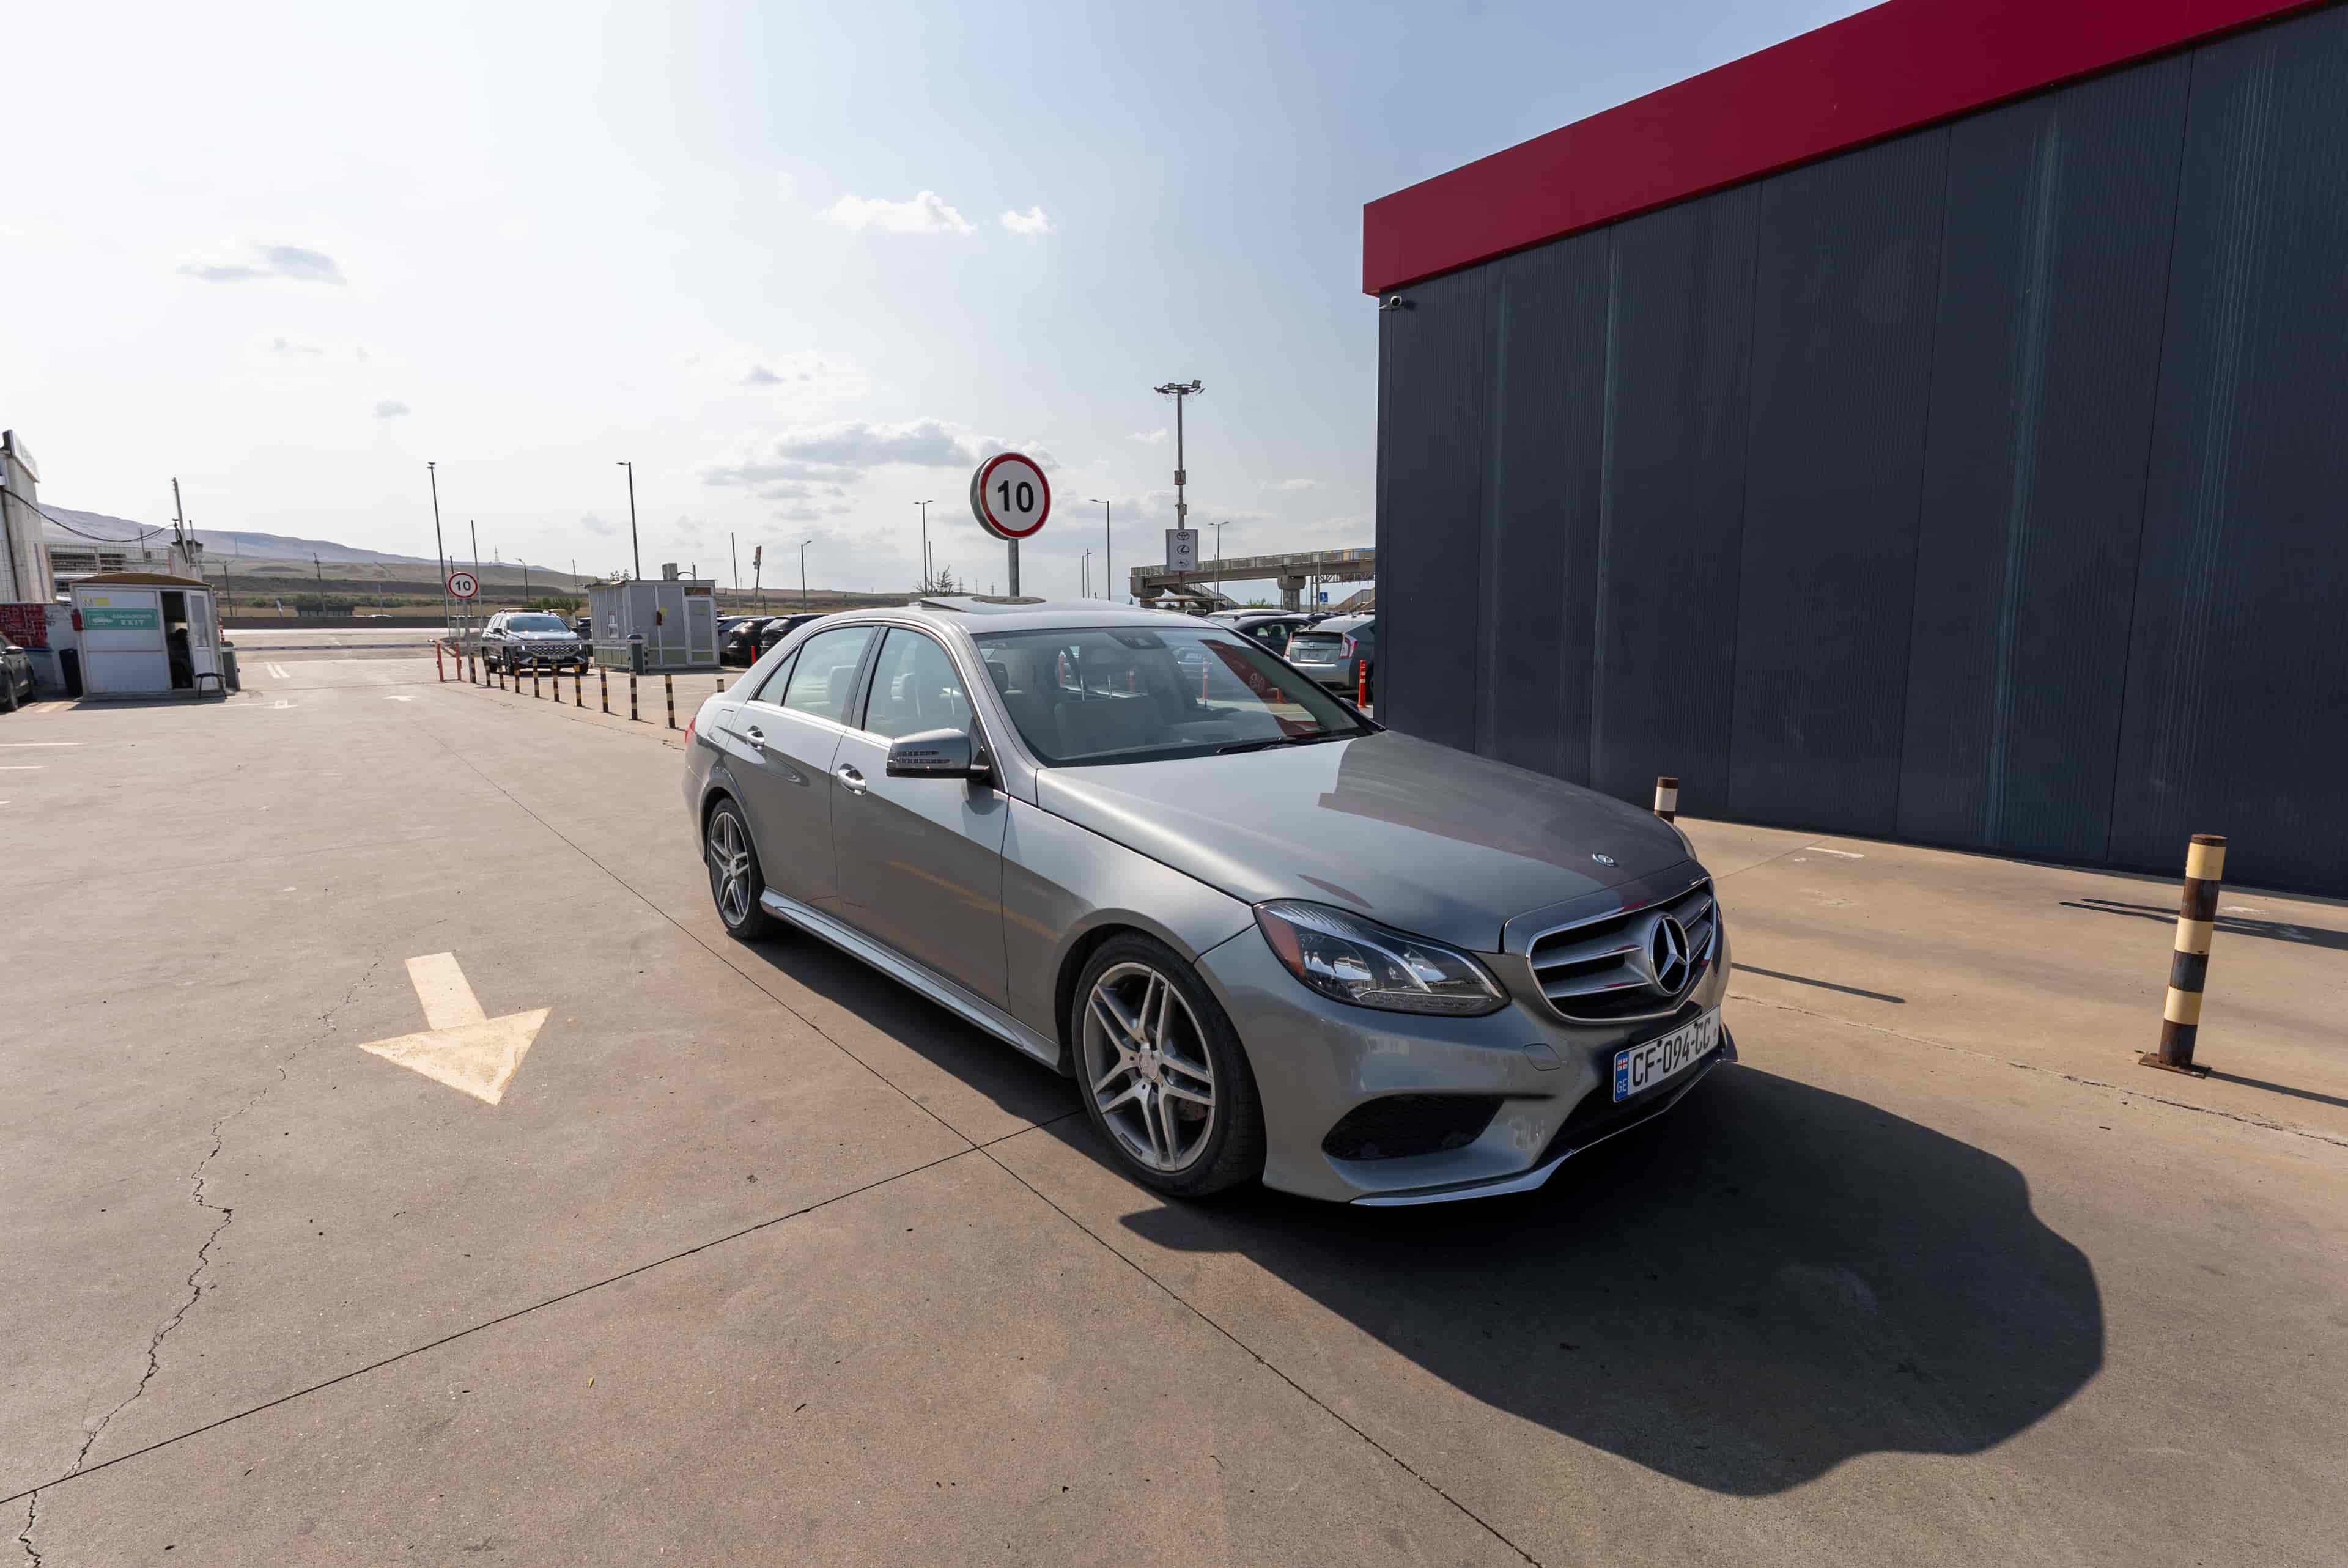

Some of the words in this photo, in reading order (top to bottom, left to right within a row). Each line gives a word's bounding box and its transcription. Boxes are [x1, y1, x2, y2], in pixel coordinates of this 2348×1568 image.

[997, 479, 1034, 513] 10
[455, 580, 471, 591] 10
[1632, 1017, 1711, 1087] CF-094-CC
[1616, 1078, 1628, 1094] GE
